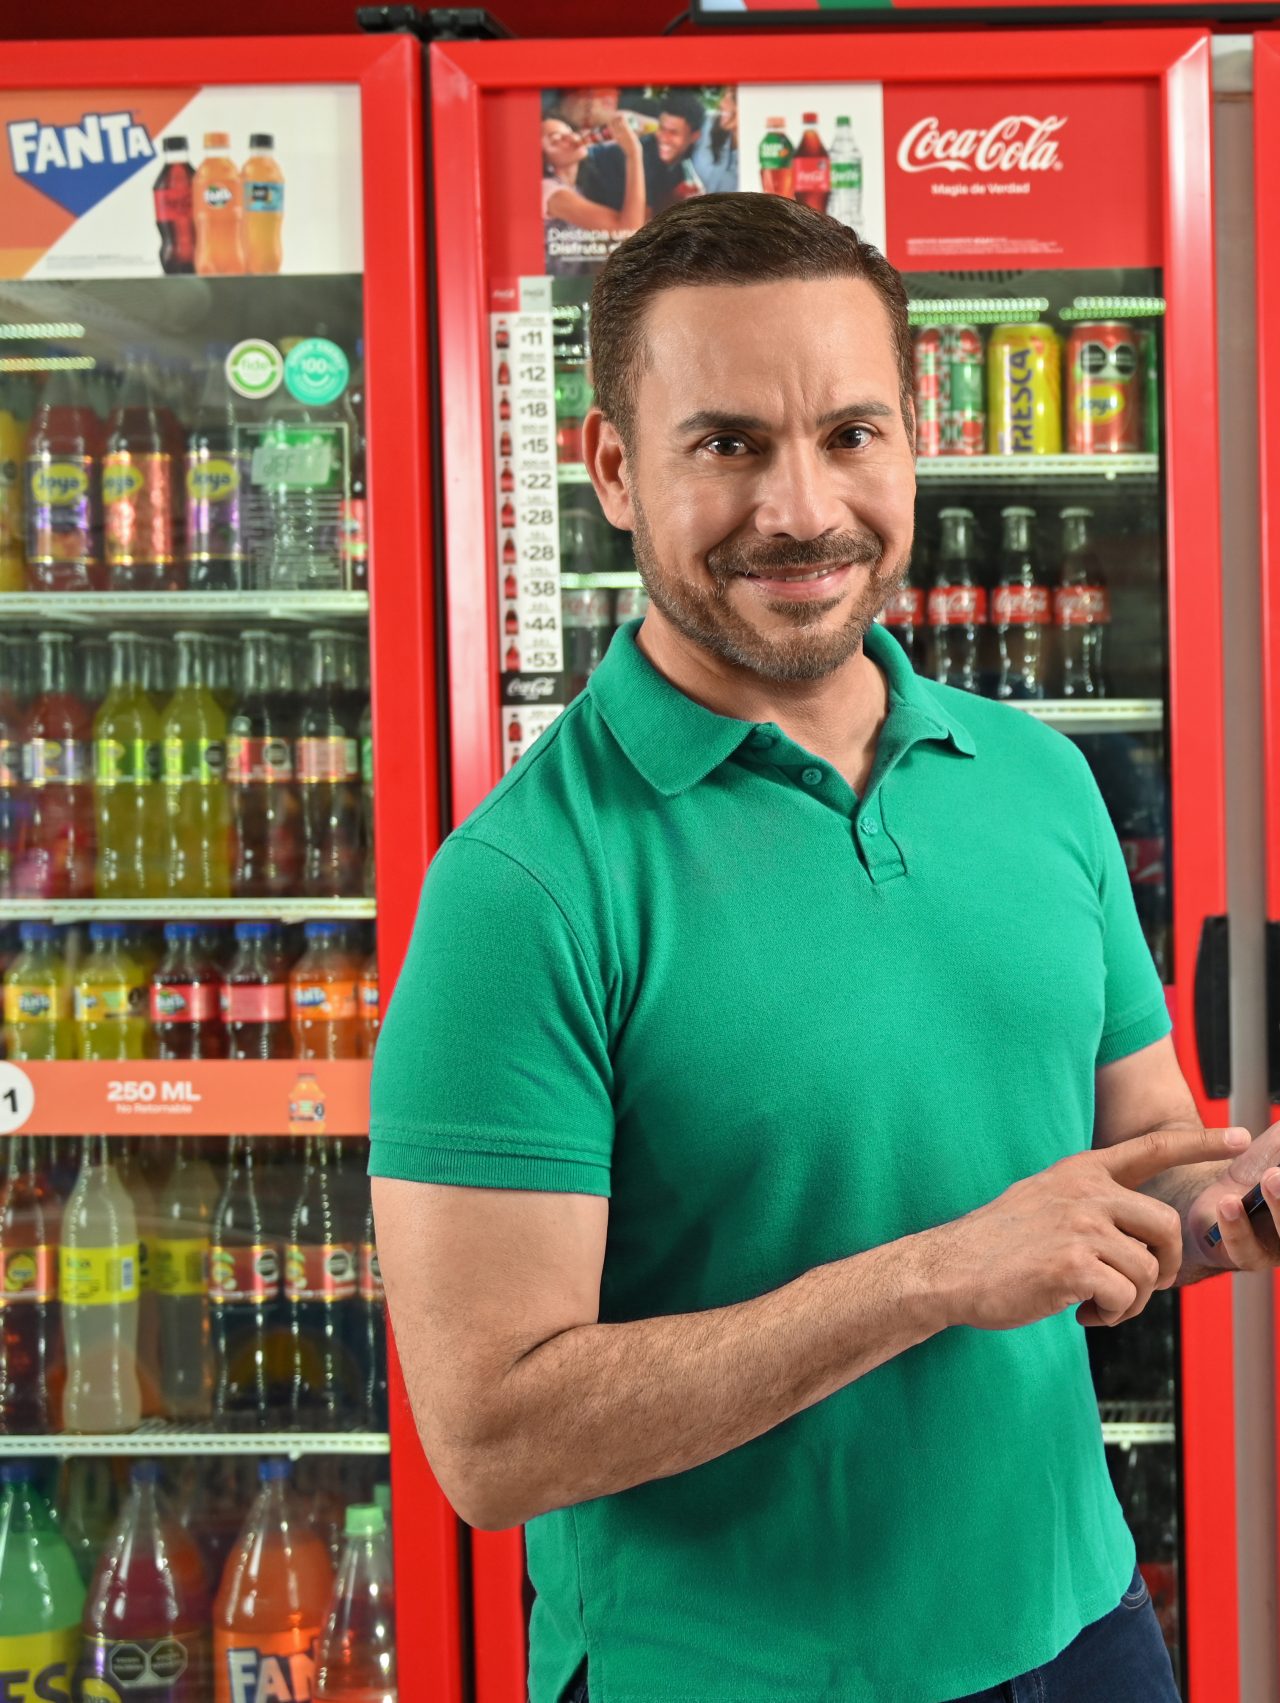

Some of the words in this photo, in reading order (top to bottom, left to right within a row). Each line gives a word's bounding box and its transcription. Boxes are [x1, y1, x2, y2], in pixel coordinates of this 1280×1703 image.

[8, 112, 153, 173] FANTA
[897, 115, 1069, 173] Coca-Cola
[931, 183, 968, 197] Magia
[970, 182, 986, 194] de
[988, 182, 1030, 195] Verdad
[1011, 347, 1033, 452] FRESCA
[107, 1081, 156, 1102] 250
[161, 1081, 202, 1101] ML
[116, 1103, 131, 1114] No
[134, 1102, 193, 1114] Retornable
